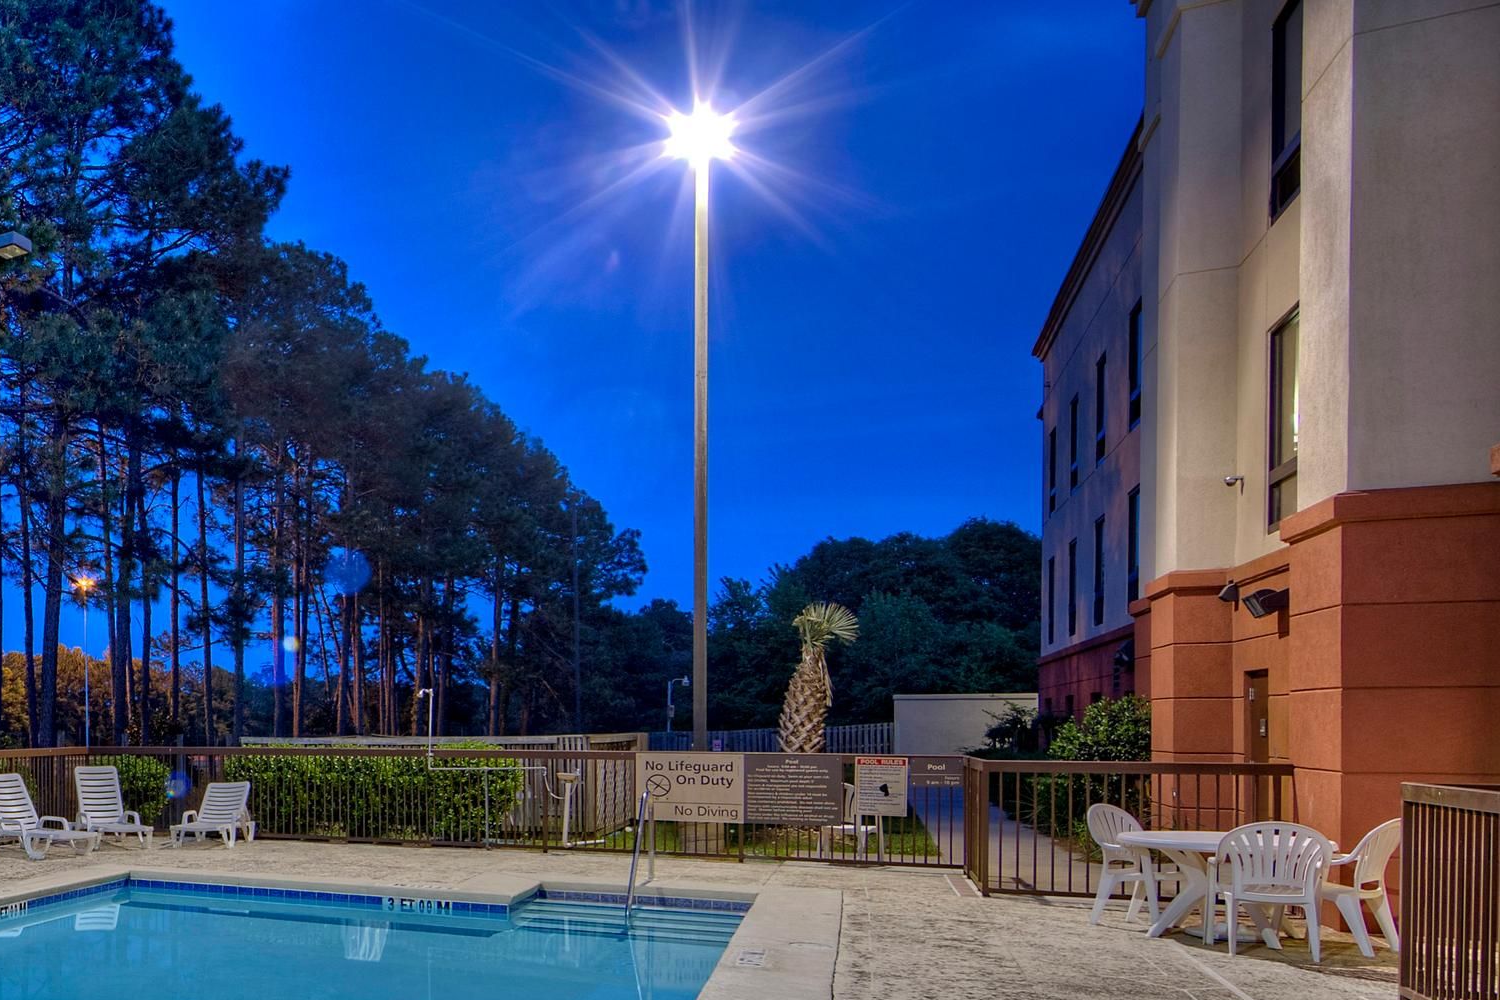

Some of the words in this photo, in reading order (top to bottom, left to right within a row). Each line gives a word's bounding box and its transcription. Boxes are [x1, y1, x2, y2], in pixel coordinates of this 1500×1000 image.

[645, 761, 663, 771] No
[669, 761, 733, 774] Lifeguard
[927, 763, 946, 771] Pool
[676, 775, 696, 785] On
[700, 775, 734, 788] Duty
[674, 805, 693, 816] No
[697, 806, 738, 820] Diving
